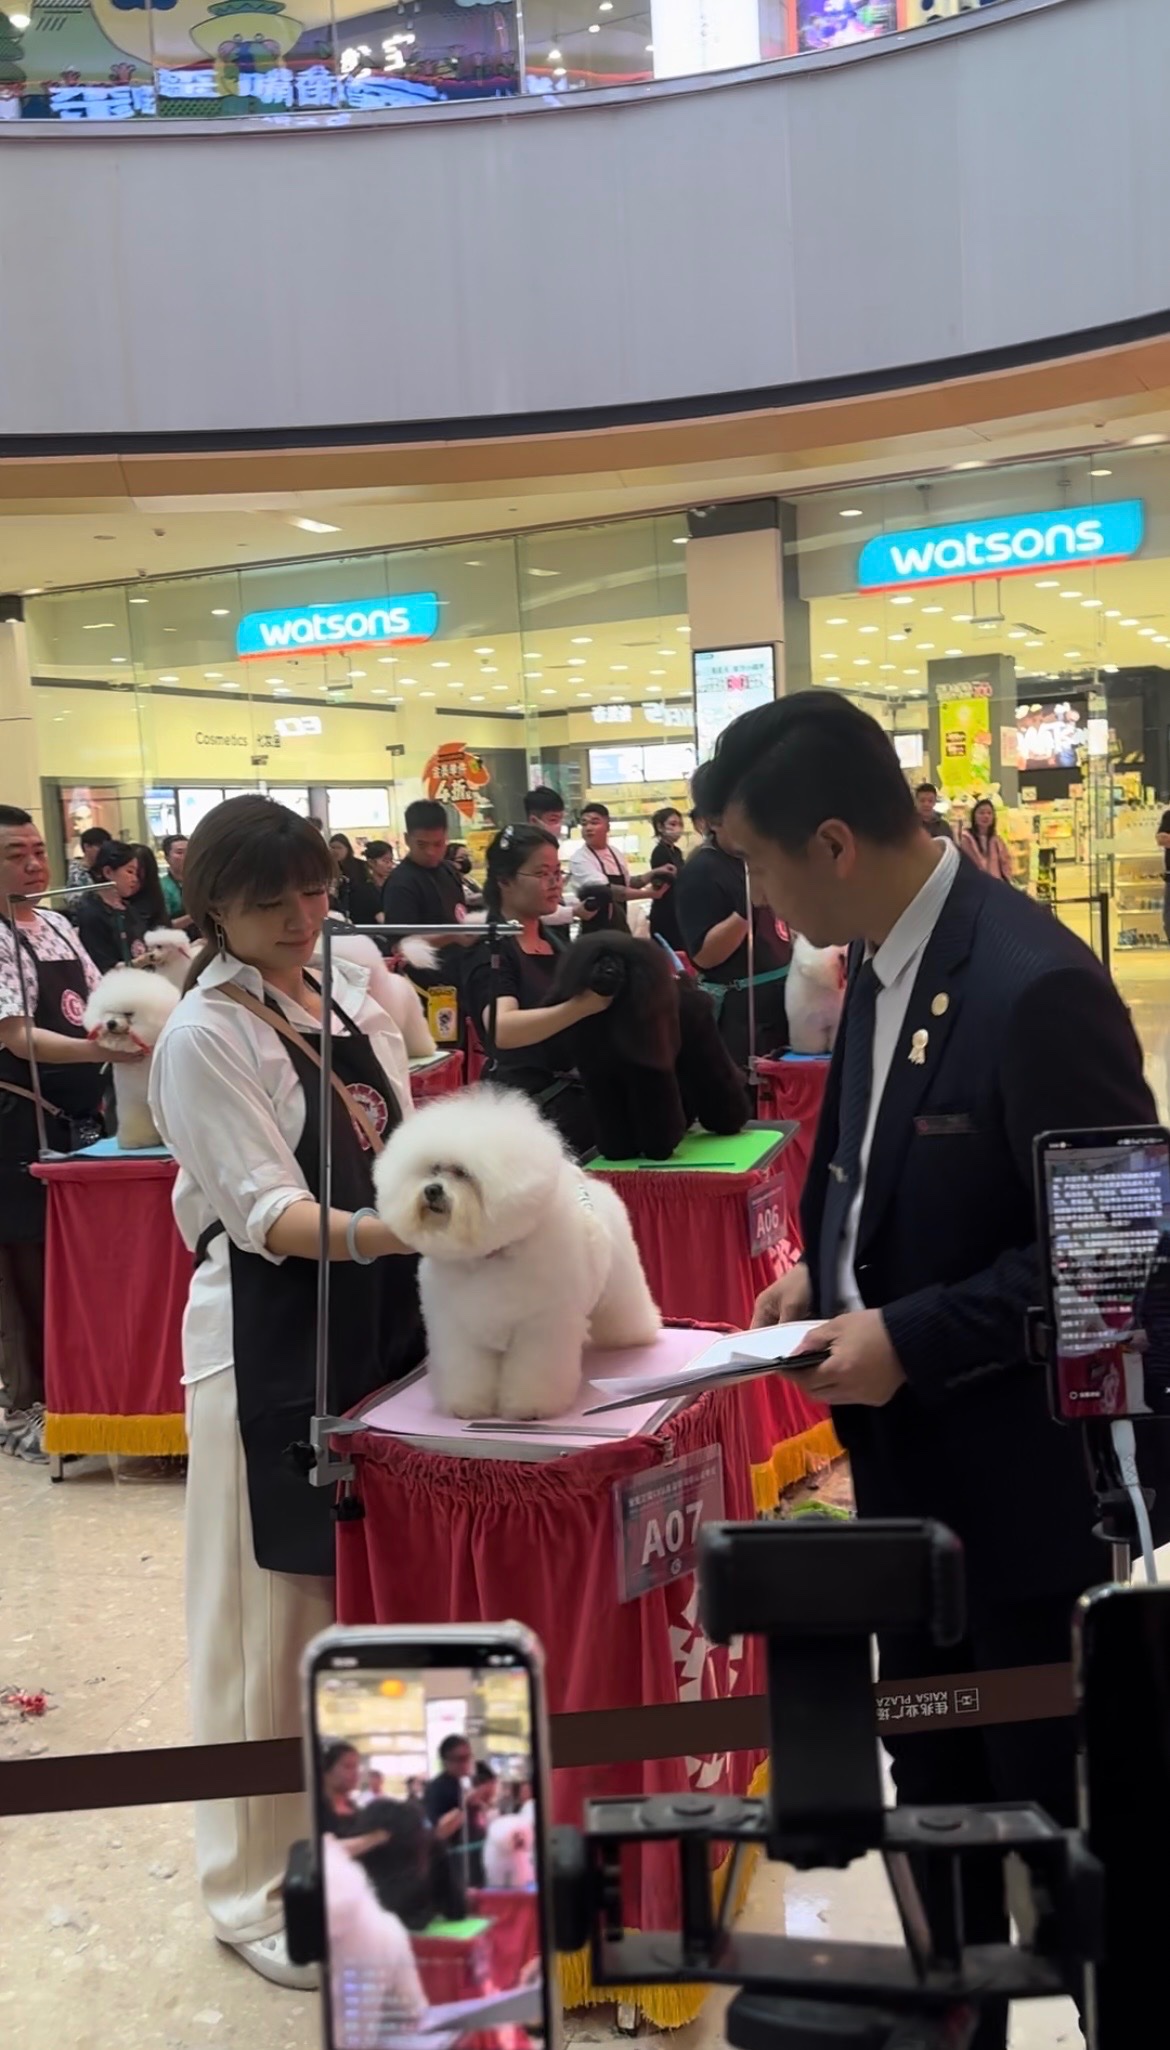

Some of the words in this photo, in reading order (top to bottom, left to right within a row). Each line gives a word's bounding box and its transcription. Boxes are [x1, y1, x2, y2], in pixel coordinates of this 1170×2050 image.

[890, 520, 1104, 574] watsons
[260, 607, 410, 646] watsons
[195, 732, 248, 746] Cosmetics
[756, 1204, 779, 1239] A06
[641, 1499, 704, 1565] A07
[876, 1695, 911, 1707] PLAZA
[916, 1691, 948, 1704] KAISA
[877, 1702, 948, 1721] 佳兆业广场
